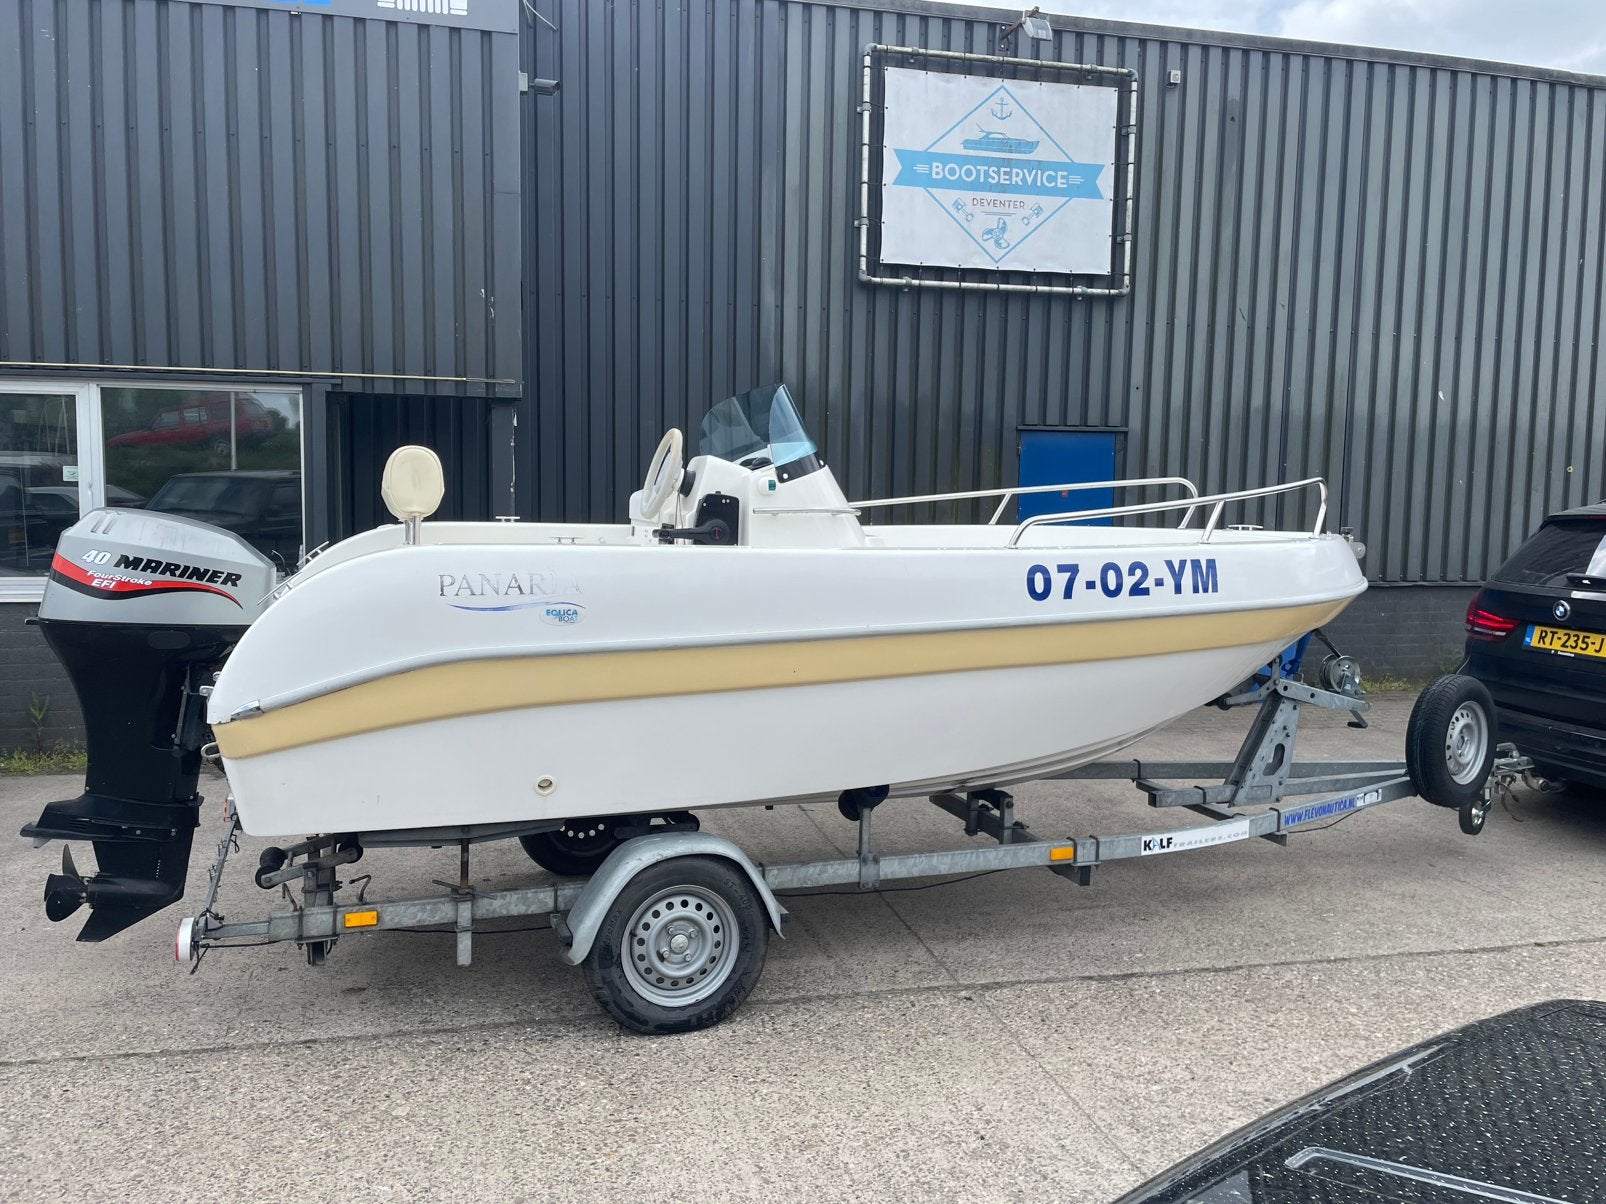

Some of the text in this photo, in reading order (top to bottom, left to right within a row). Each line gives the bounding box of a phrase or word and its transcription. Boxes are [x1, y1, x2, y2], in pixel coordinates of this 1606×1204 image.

[931, 162, 1068, 188] BOOTSERVICE
[972, 197, 1026, 210] DEVENTER
[81, 549, 242, 588] 40 MARINER
[87, 570, 153, 586] FourStroke
[1026, 558, 1219, 601] 07-02-YM
[91, 578, 115, 589] EFI
[1537, 628, 1605, 653] RT-235-J
[1284, 796, 1356, 826] WWW.FLEVONAUTICA.NL
[1143, 836, 1173, 852] KALF
